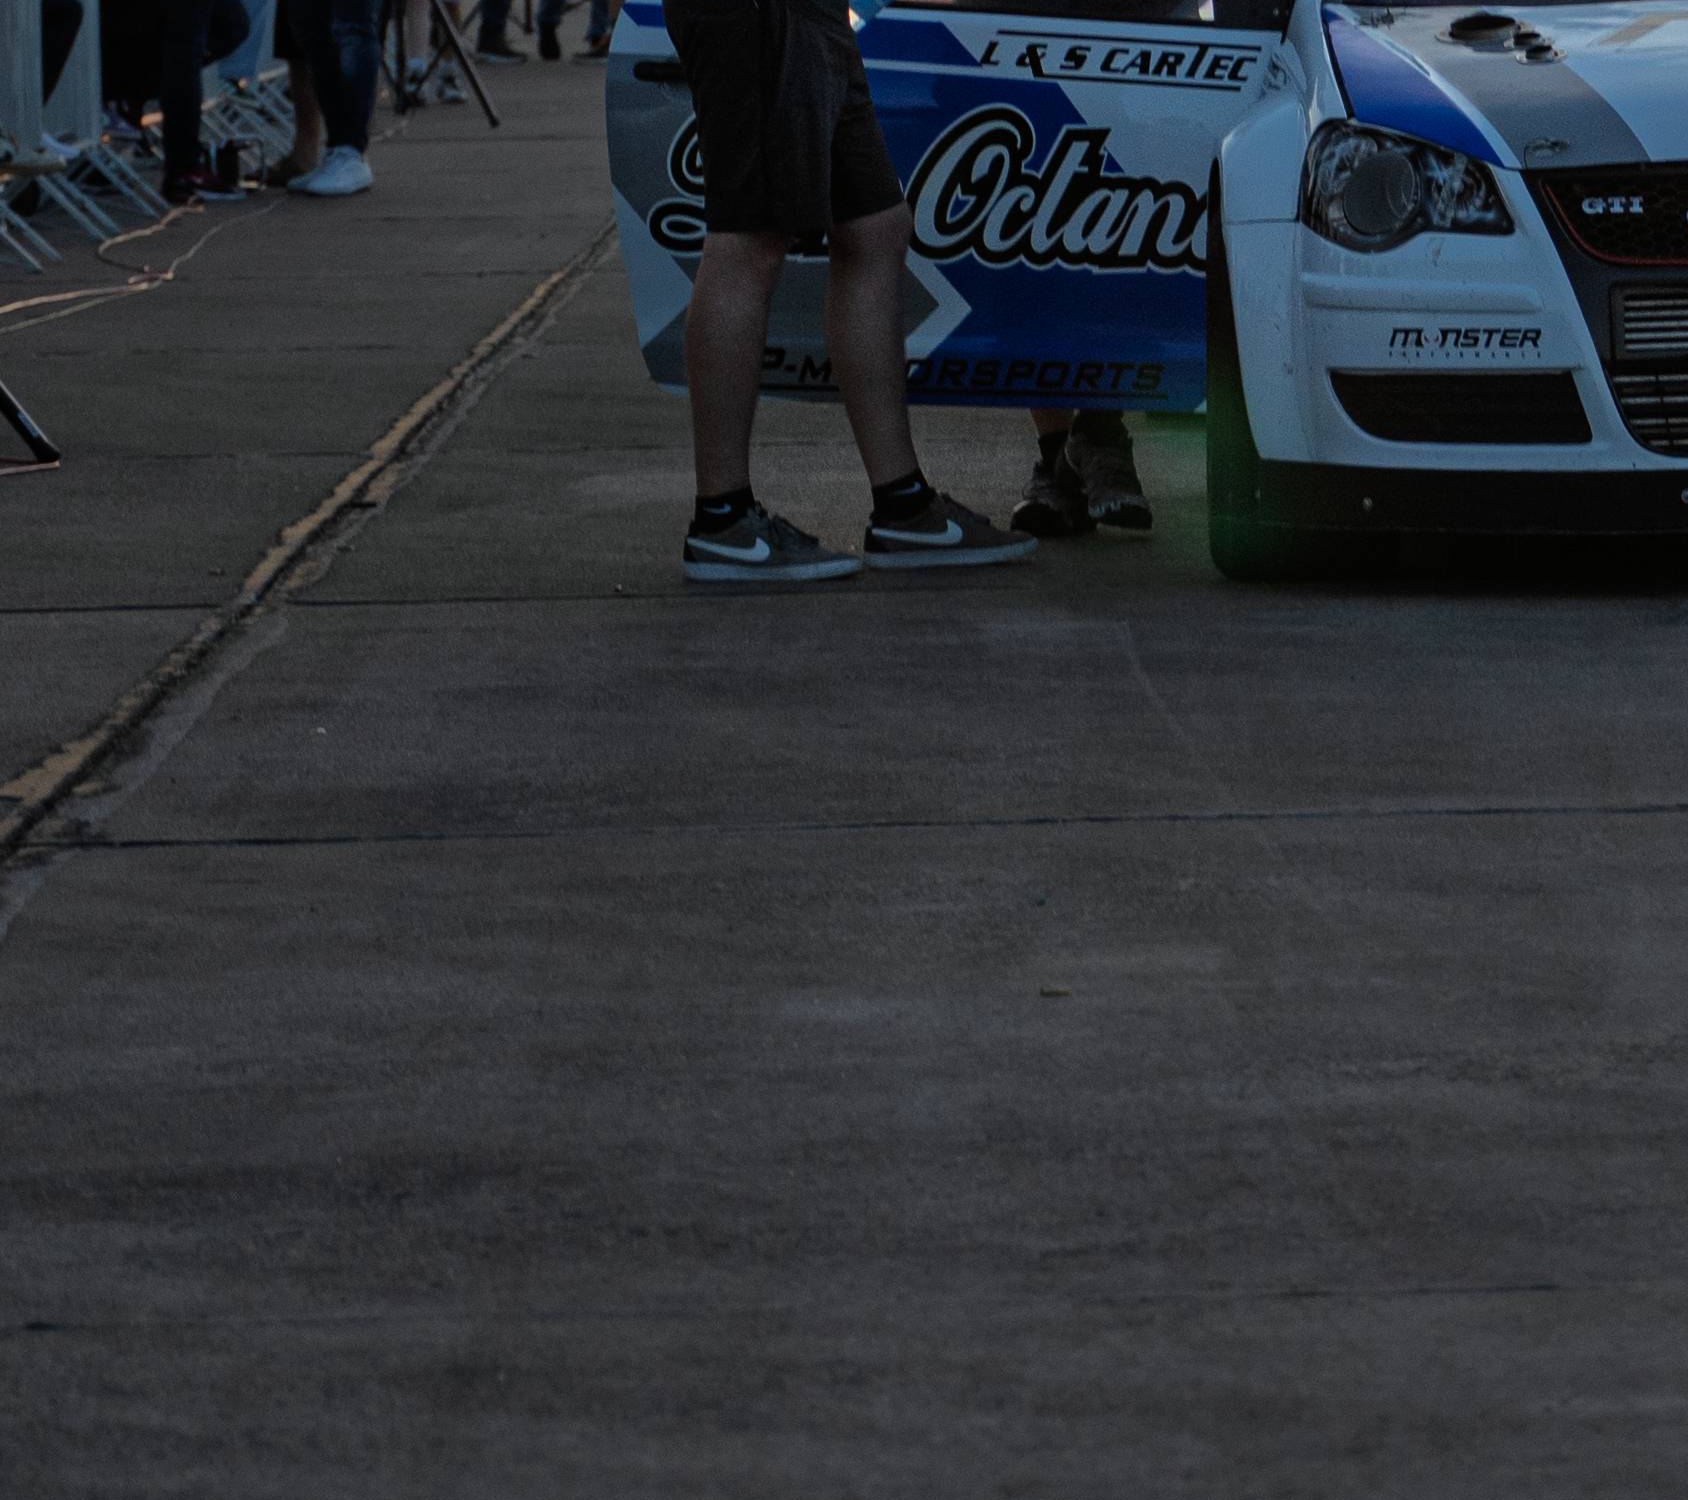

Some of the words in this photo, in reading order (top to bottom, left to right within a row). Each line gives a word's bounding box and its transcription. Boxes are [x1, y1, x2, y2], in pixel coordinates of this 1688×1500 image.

[980, 41, 999, 66] L
[1016, 43, 1048, 78] &
[1060, 45, 1092, 70] S
[1581, 196, 1644, 215] GTI
[761, 347, 1166, 391] P-MORSPORTS
